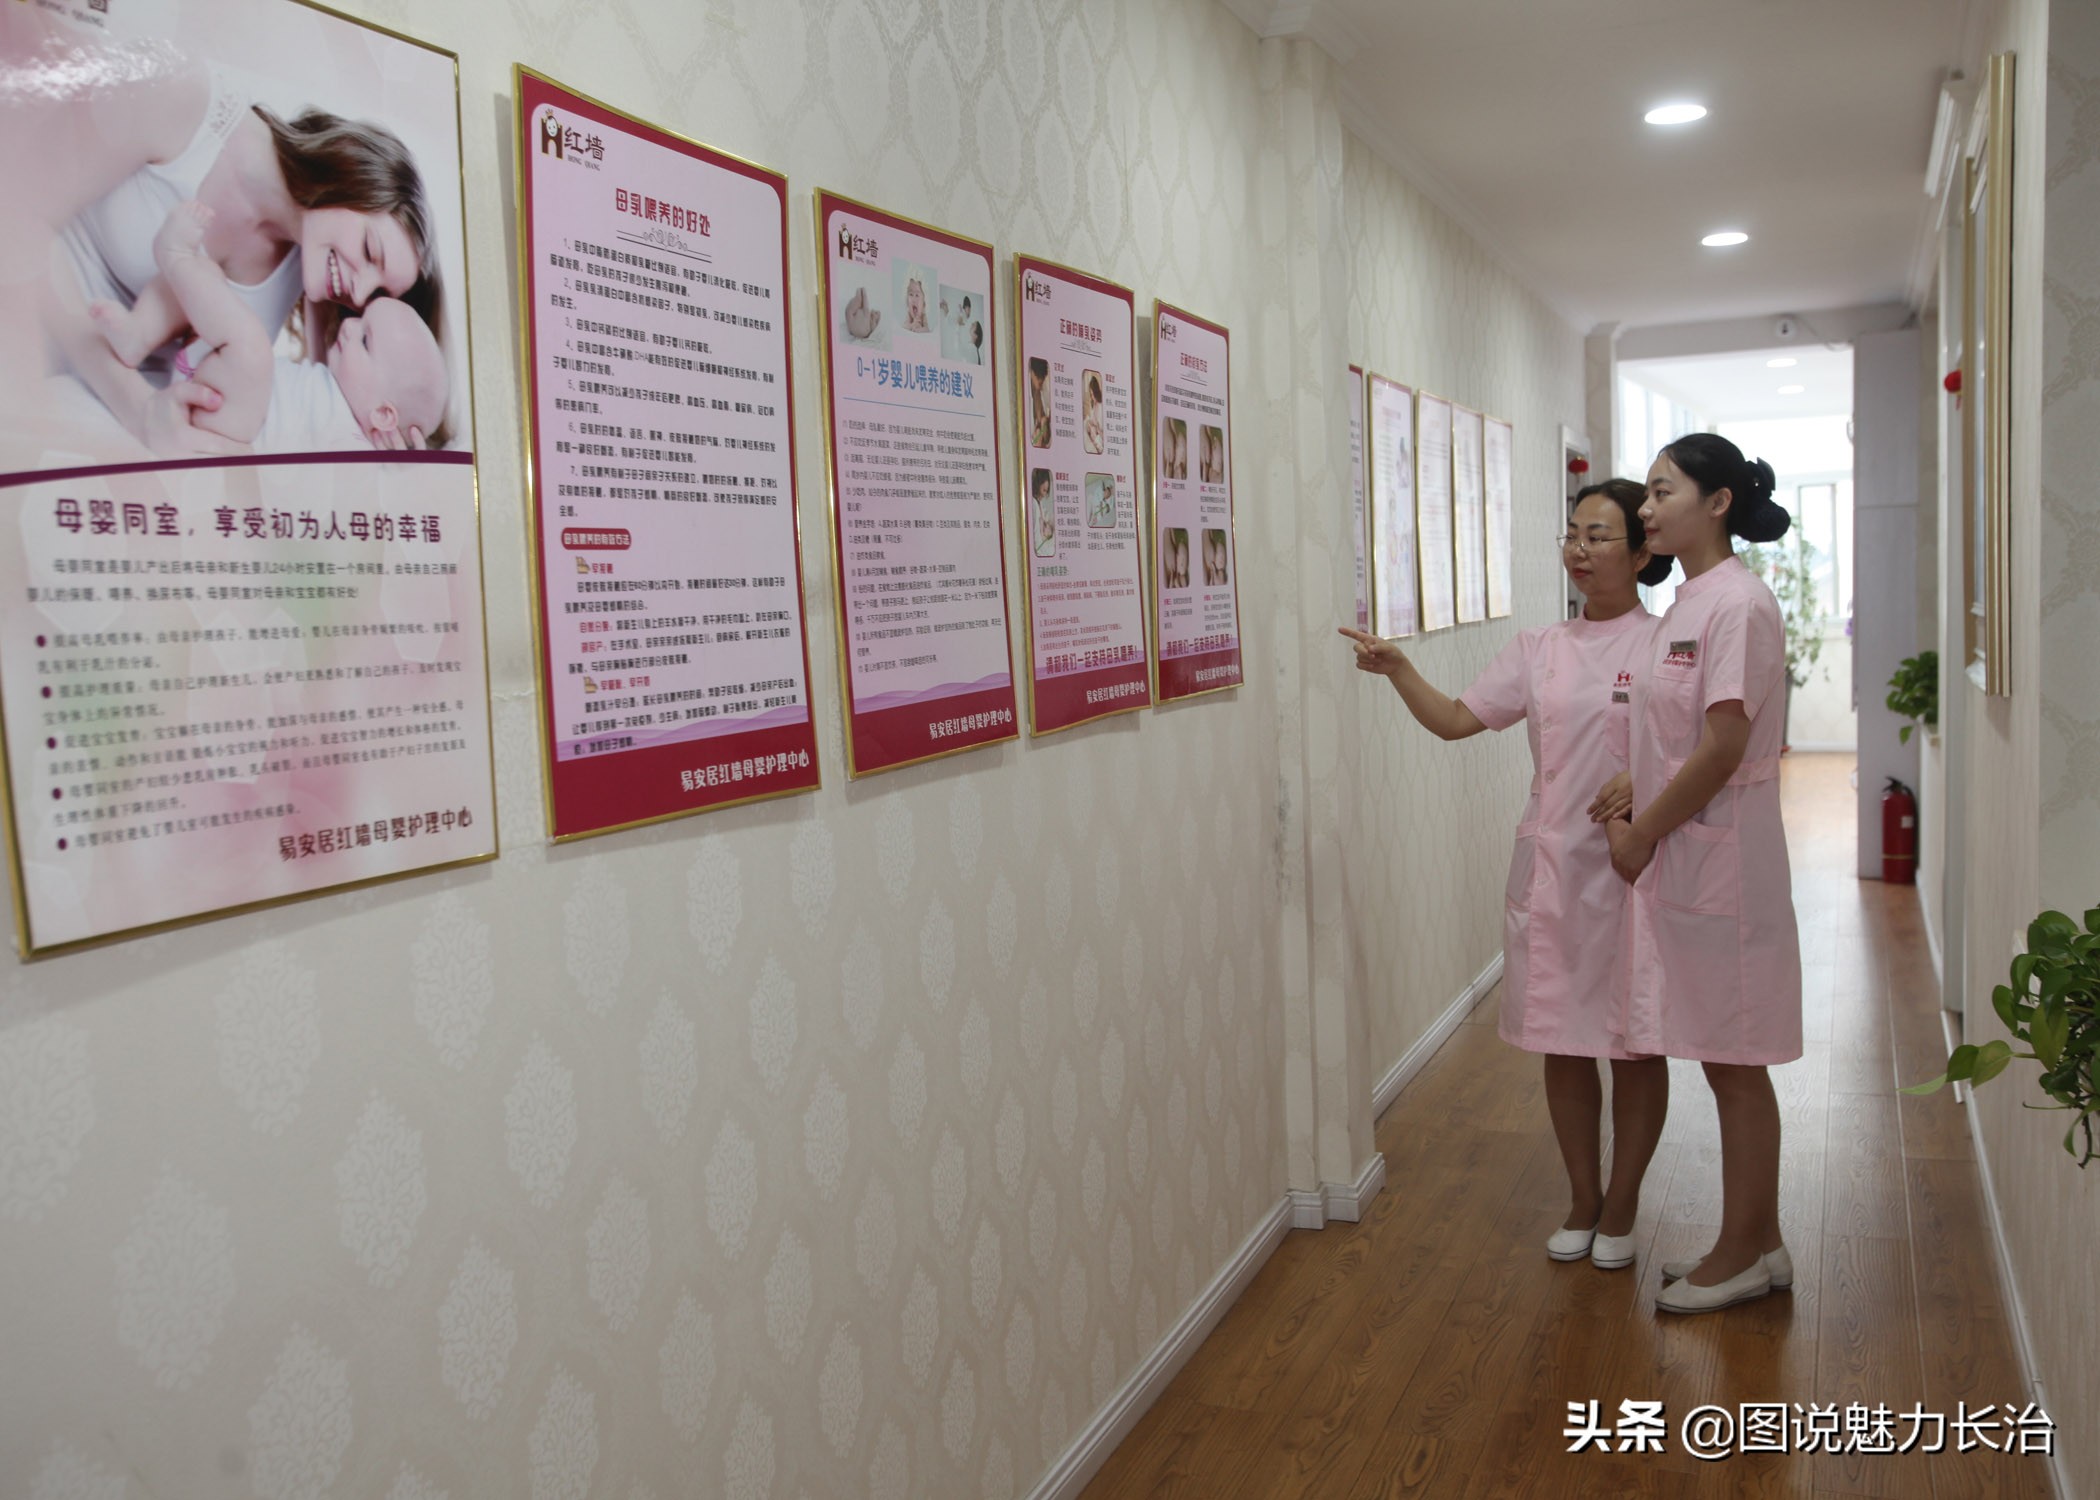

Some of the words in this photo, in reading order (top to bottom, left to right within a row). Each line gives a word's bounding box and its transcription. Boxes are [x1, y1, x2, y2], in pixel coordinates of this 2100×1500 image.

[564, 126, 605, 162] 红墙
[615, 187, 712, 238] 母乳喂养的好处
[852, 234, 879, 259] 红墙
[1034, 282, 1052, 299] 红墙
[857, 356, 974, 399] 0-1岁婴儿喂养的建议
[928, 707, 1013, 740] 易安居红墙母婴护理中心
[680, 747, 810, 791] 易安居红墙母婴护理中心
[279, 806, 474, 862] 易安居红墙母婴护理中心
